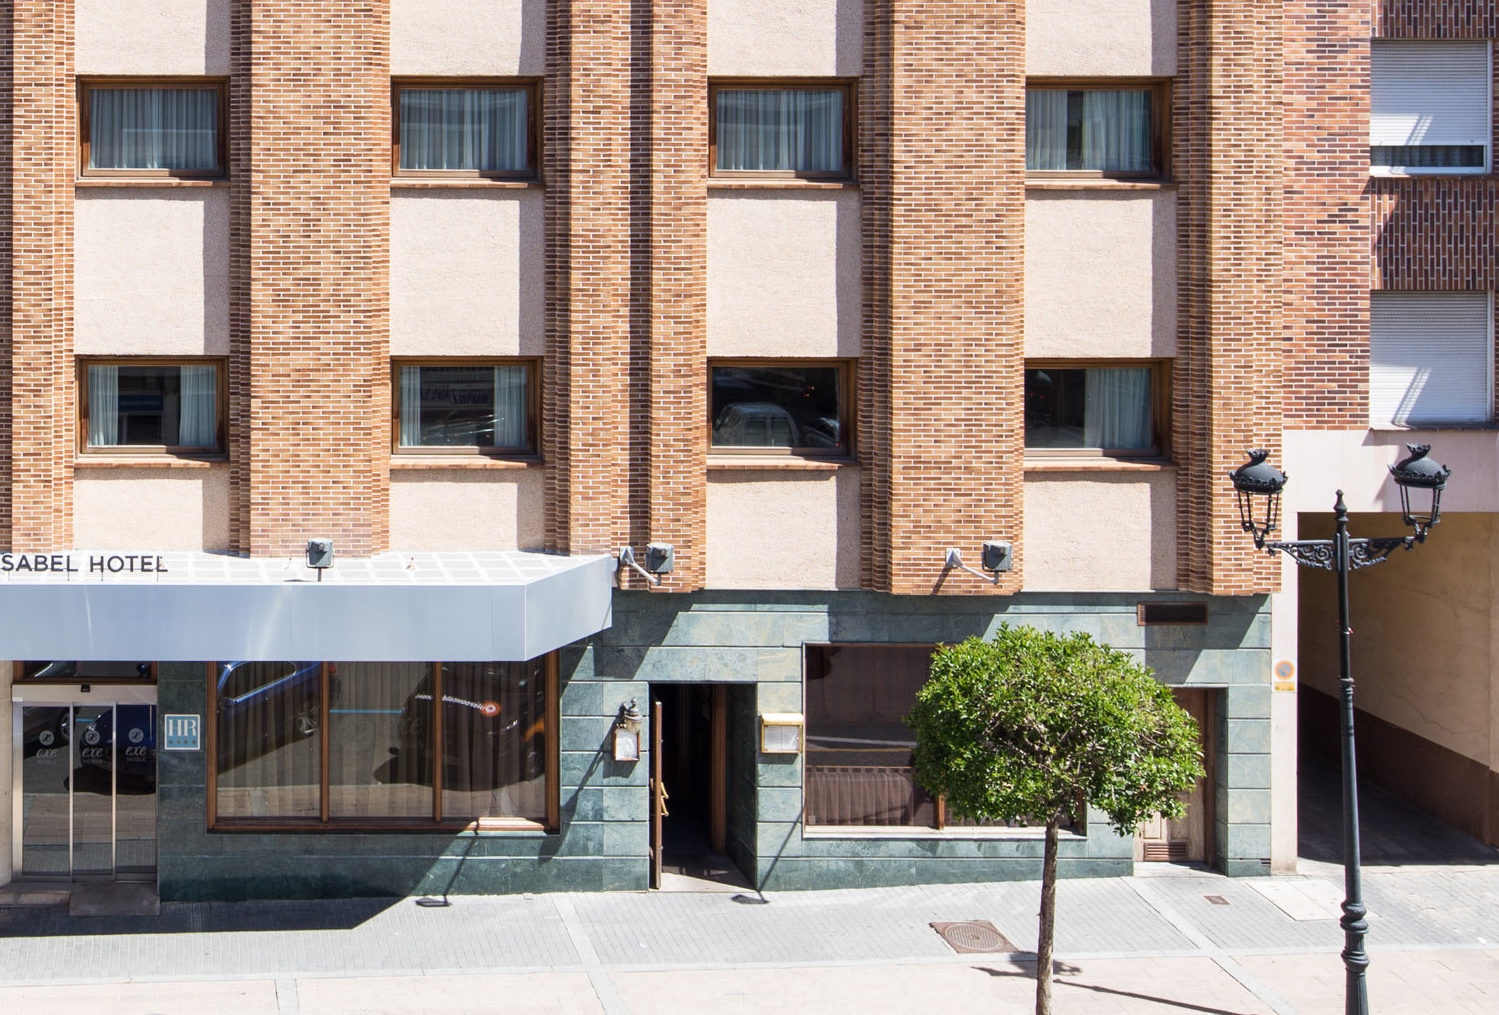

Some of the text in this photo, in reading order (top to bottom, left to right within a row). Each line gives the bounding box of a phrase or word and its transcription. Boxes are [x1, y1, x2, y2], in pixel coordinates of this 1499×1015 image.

[89, 555, 168, 574] HOTEL
[168, 719, 197, 737] HR
[36, 748, 58, 759] exe
[82, 747, 103, 758] exe
[125, 746, 147, 756] exe
